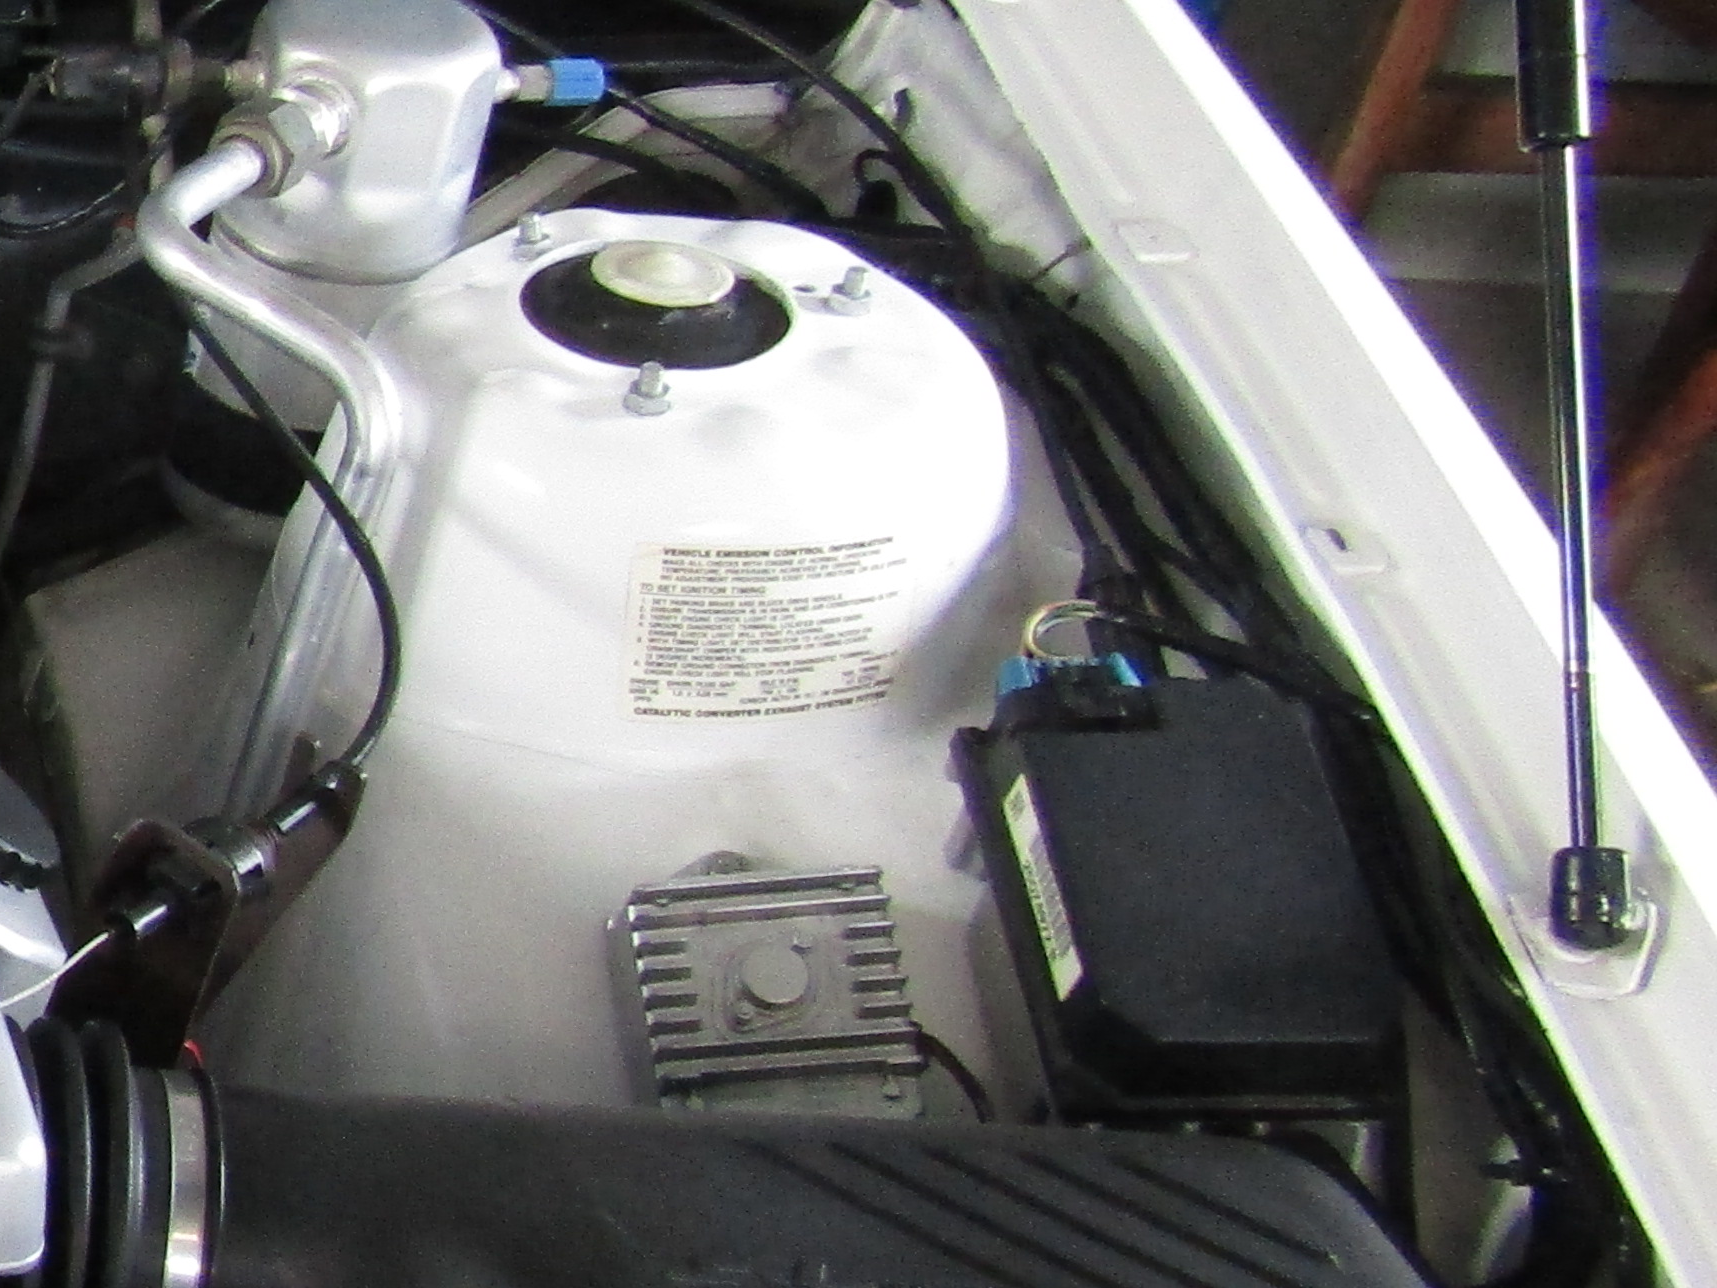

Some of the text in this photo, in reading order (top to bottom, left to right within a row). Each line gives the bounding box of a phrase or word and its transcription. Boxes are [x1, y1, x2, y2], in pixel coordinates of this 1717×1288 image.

[773, 547, 824, 557] CONTROL
[680, 585, 727, 594] IGNITION
[633, 707, 692, 717] CATALYTIC
[695, 708, 761, 717] CONVERTER
[764, 703, 812, 716] EXHAUST
